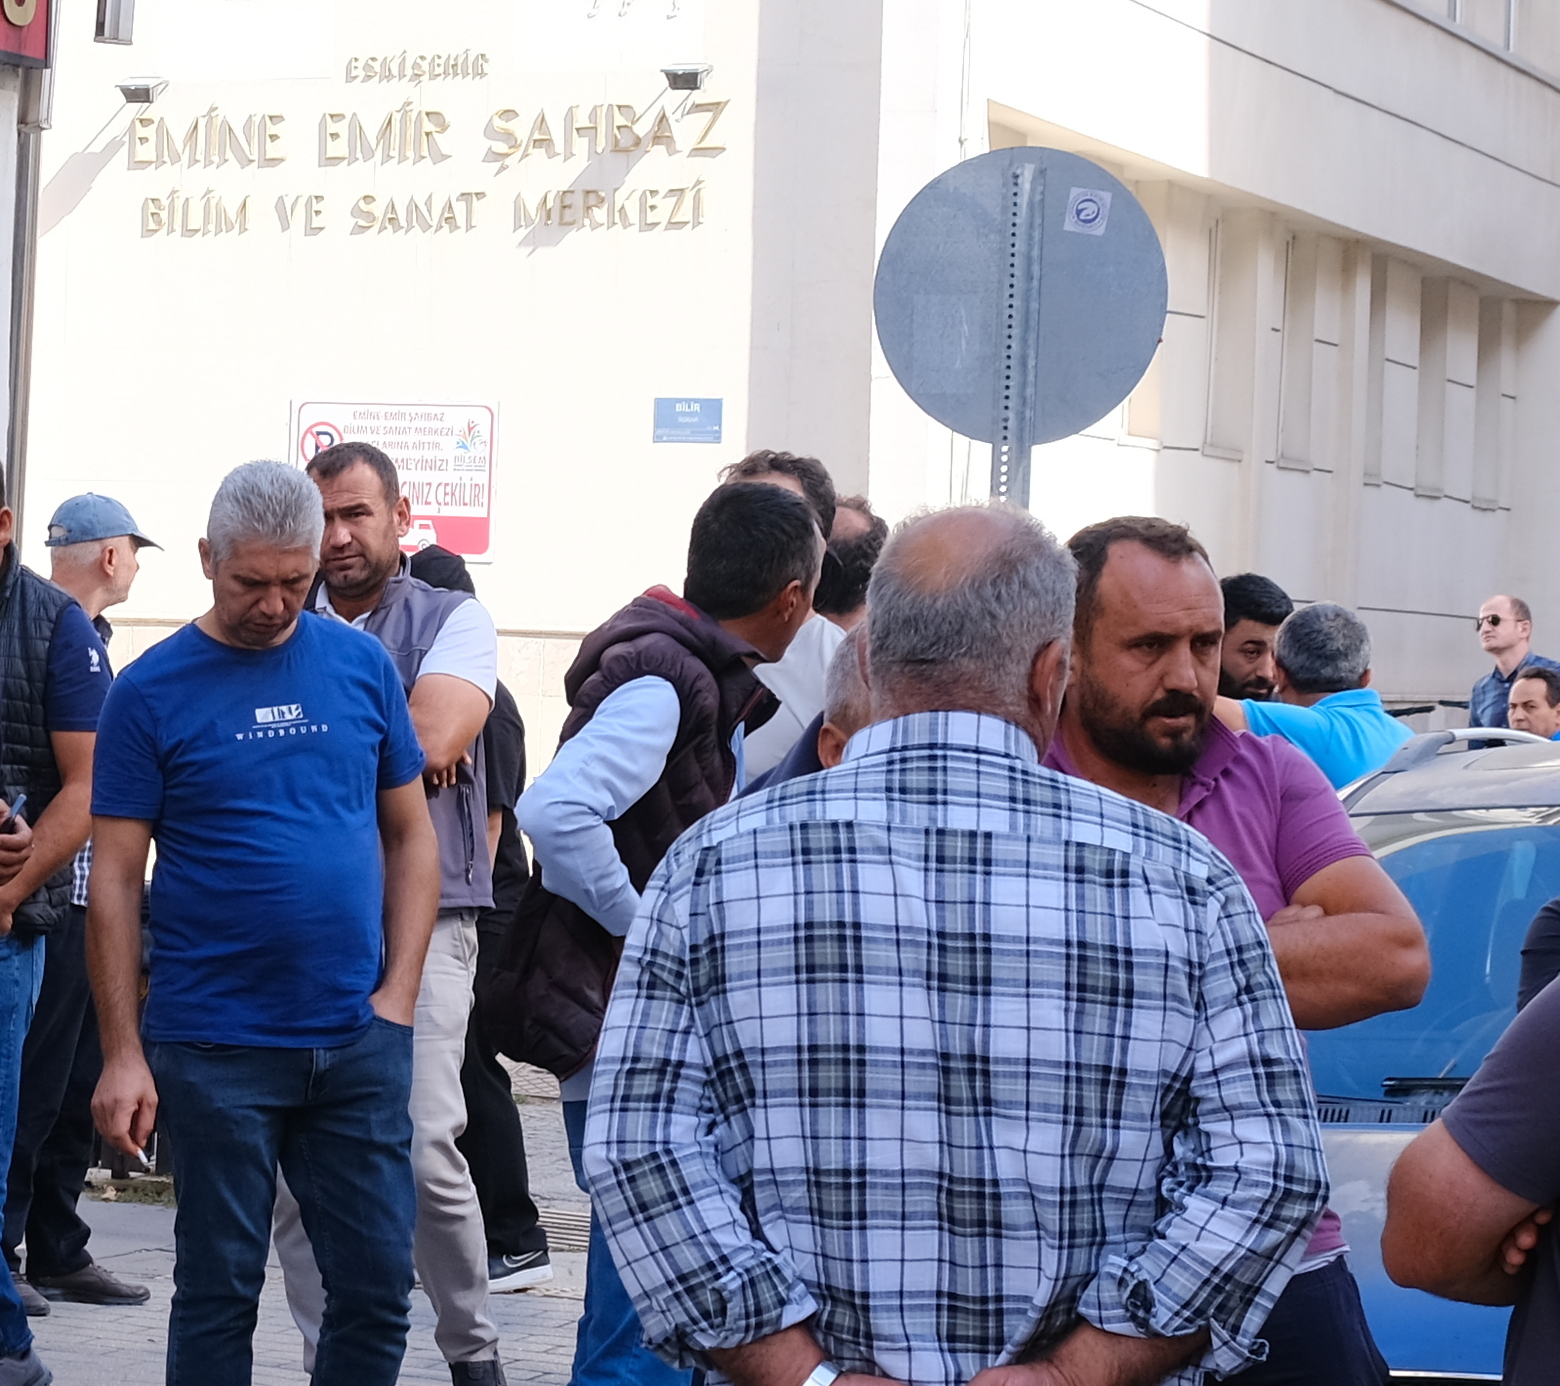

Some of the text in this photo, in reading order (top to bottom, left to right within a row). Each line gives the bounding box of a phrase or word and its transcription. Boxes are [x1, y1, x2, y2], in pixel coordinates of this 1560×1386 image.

[345, 49, 489, 88] ESKİŞEHİR
[127, 98, 730, 177] EMİNE EMİR ŞAHBAZ
[141, 175, 705, 238] BİLİM VE SANAT MERKEZİ
[235, 724, 328, 741] WINDBOUND
